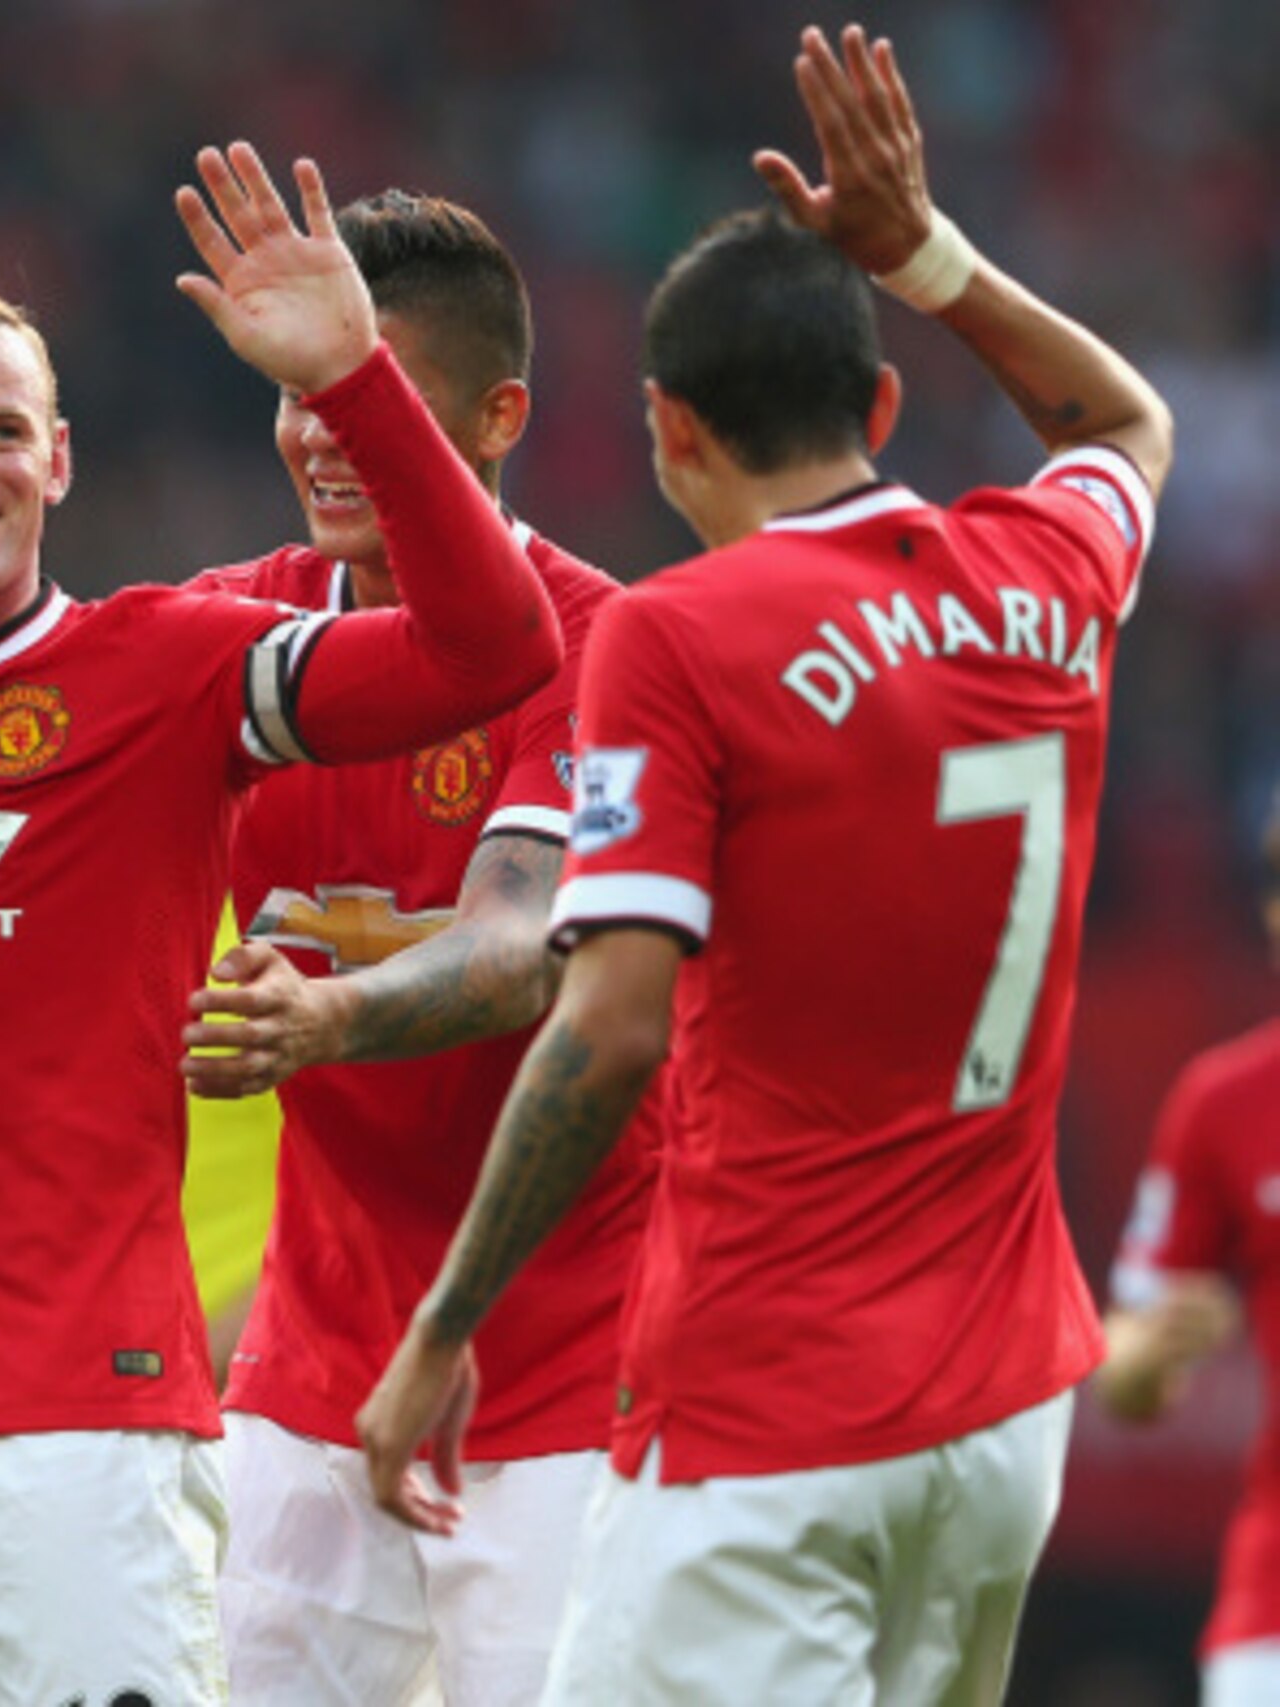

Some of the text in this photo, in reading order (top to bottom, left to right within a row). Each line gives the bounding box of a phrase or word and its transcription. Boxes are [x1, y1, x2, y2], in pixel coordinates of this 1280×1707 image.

[780, 586, 1101, 728] DI MARIA
[935, 730, 1066, 1114] 7
